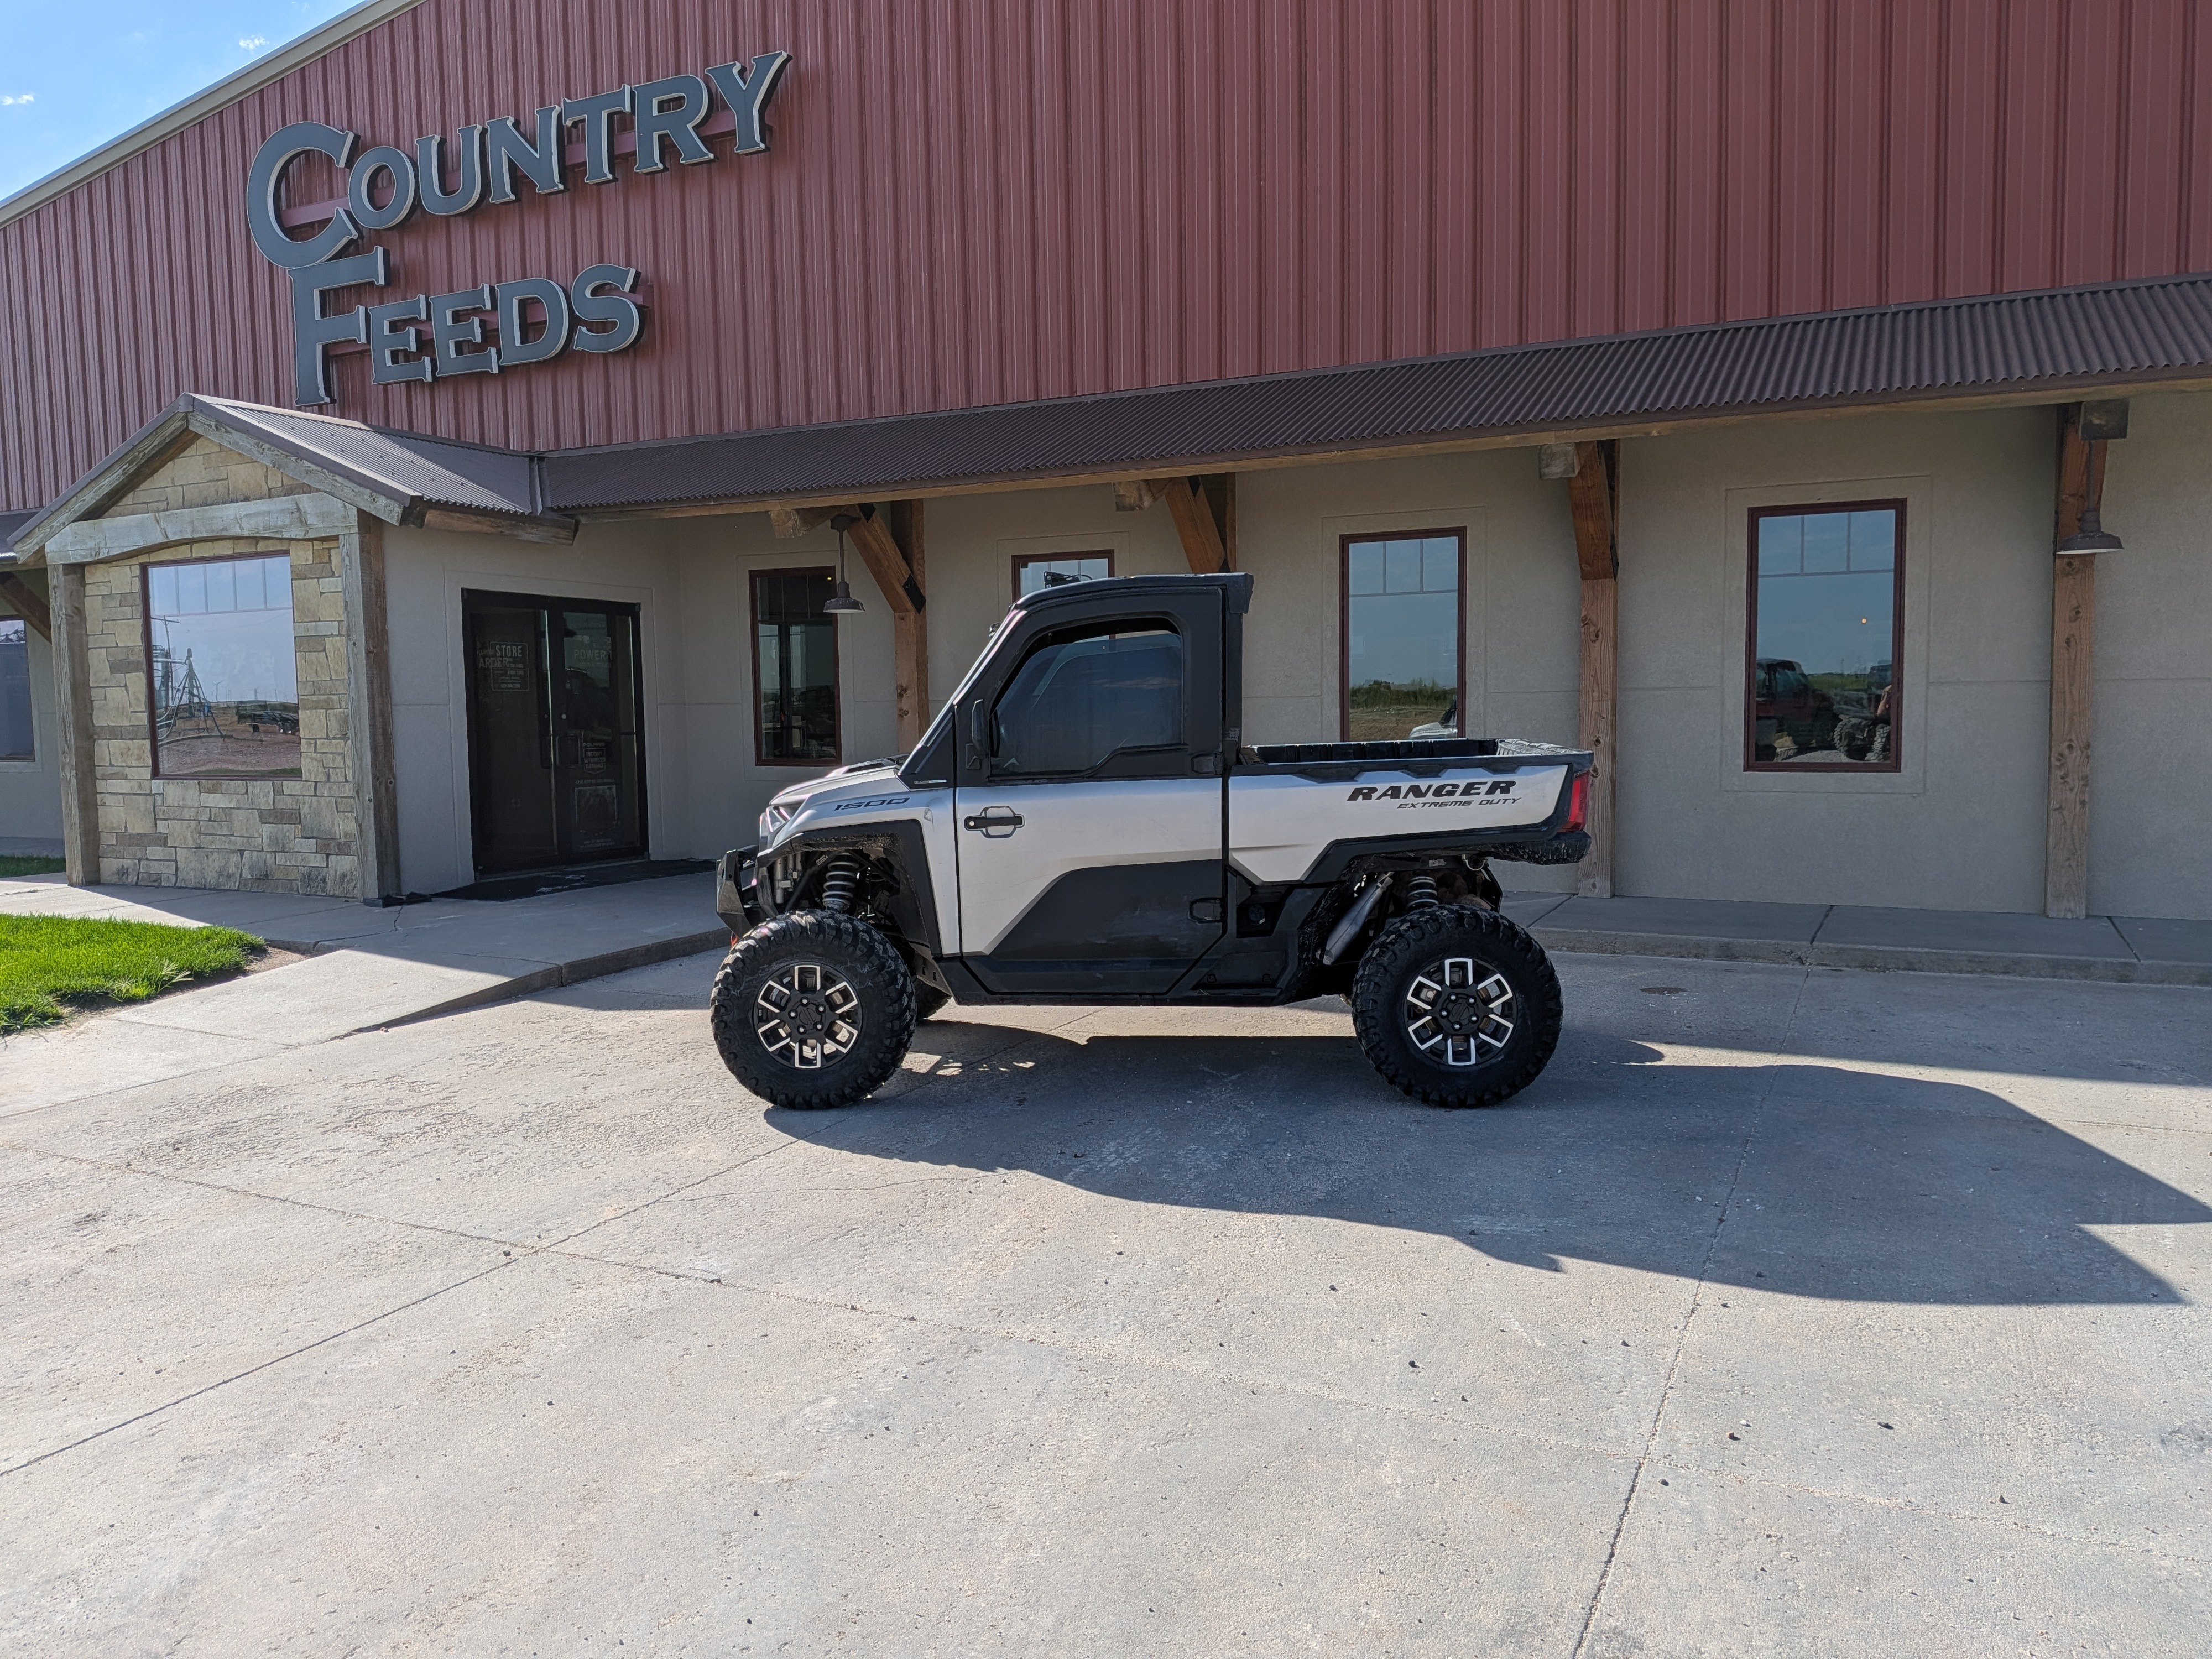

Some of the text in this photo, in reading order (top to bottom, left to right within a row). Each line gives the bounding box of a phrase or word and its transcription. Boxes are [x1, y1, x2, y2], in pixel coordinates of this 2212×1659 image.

[246, 50, 792, 269] COUNTRY
[288, 246, 643, 407] FEEDS
[495, 645, 523, 657] STORE
[1347, 780, 1516, 801] RANGER
[834, 797, 910, 811] 1500
[1396, 797, 1522, 809] EXTREME DUTY
